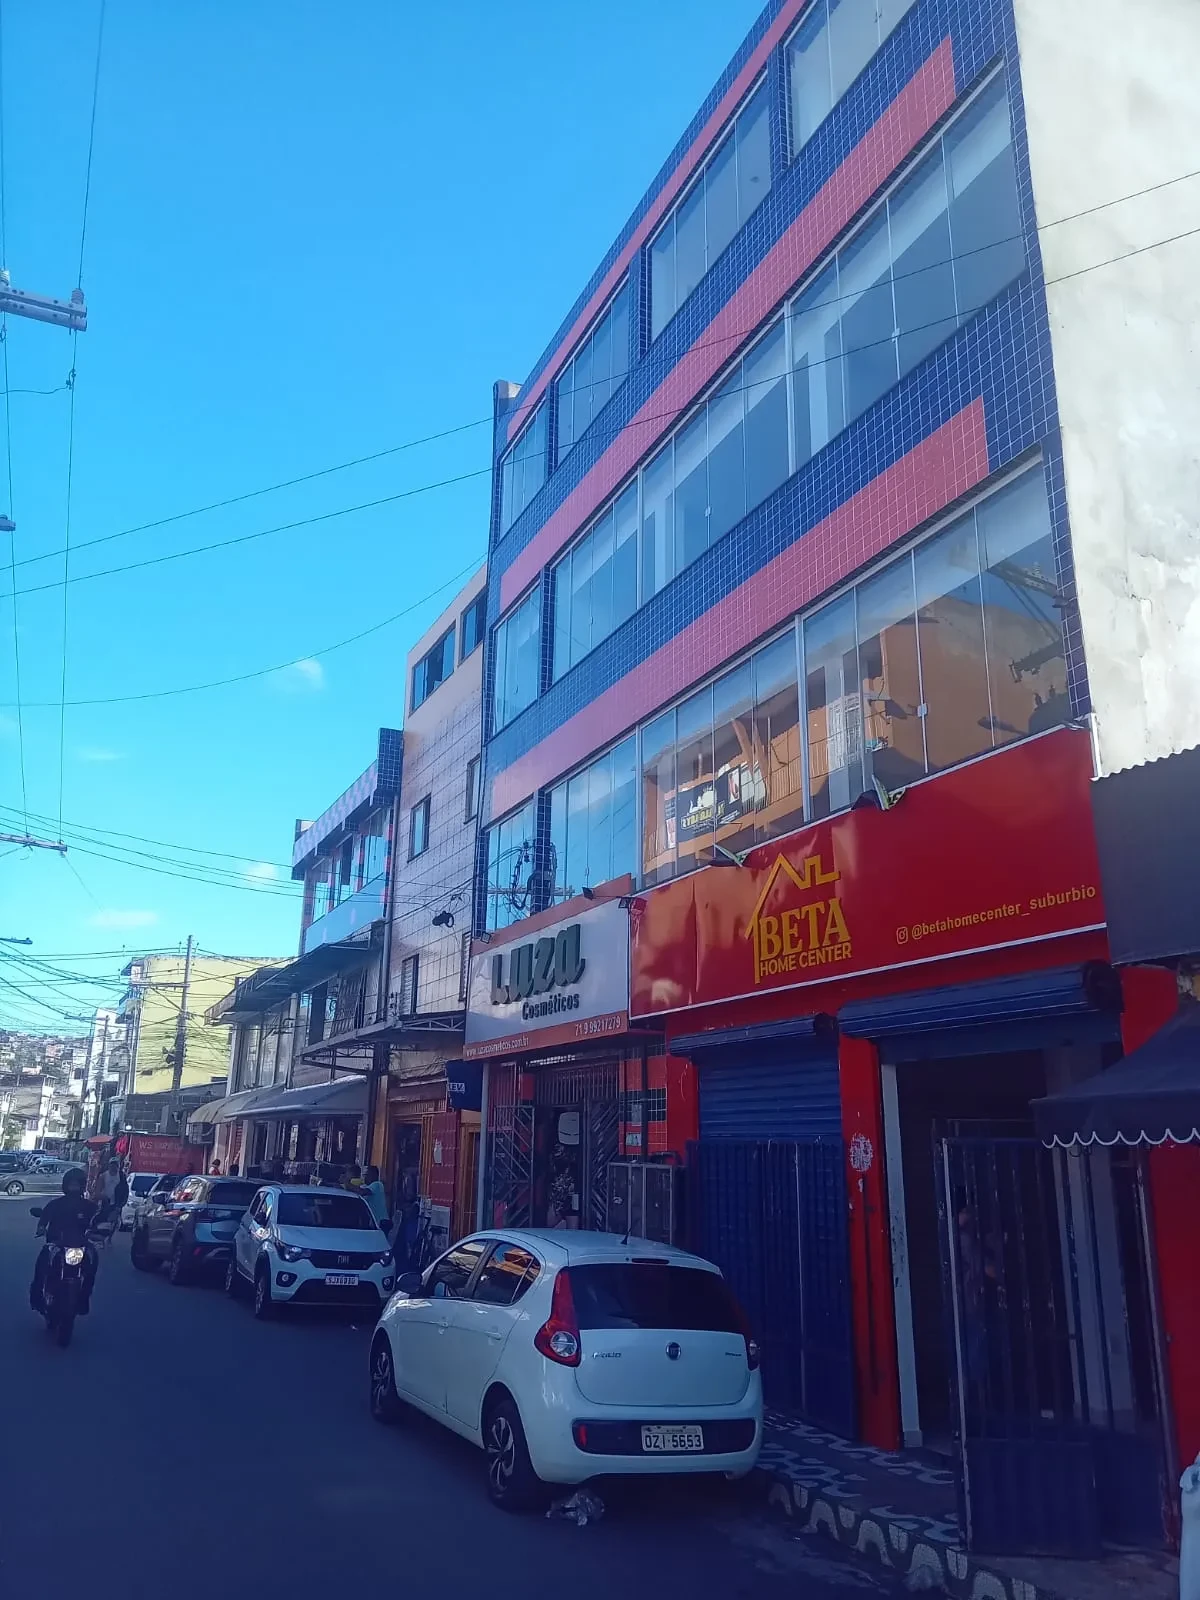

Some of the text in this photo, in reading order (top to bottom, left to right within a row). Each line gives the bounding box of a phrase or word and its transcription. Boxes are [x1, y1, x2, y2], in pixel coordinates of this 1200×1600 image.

[759, 897, 852, 961] BETA
[911, 884, 1096, 940] @betahomecenter_suburbio
[760, 941, 852, 977] HOME CENTER
[521, 993, 580, 1021] Cosméticos
